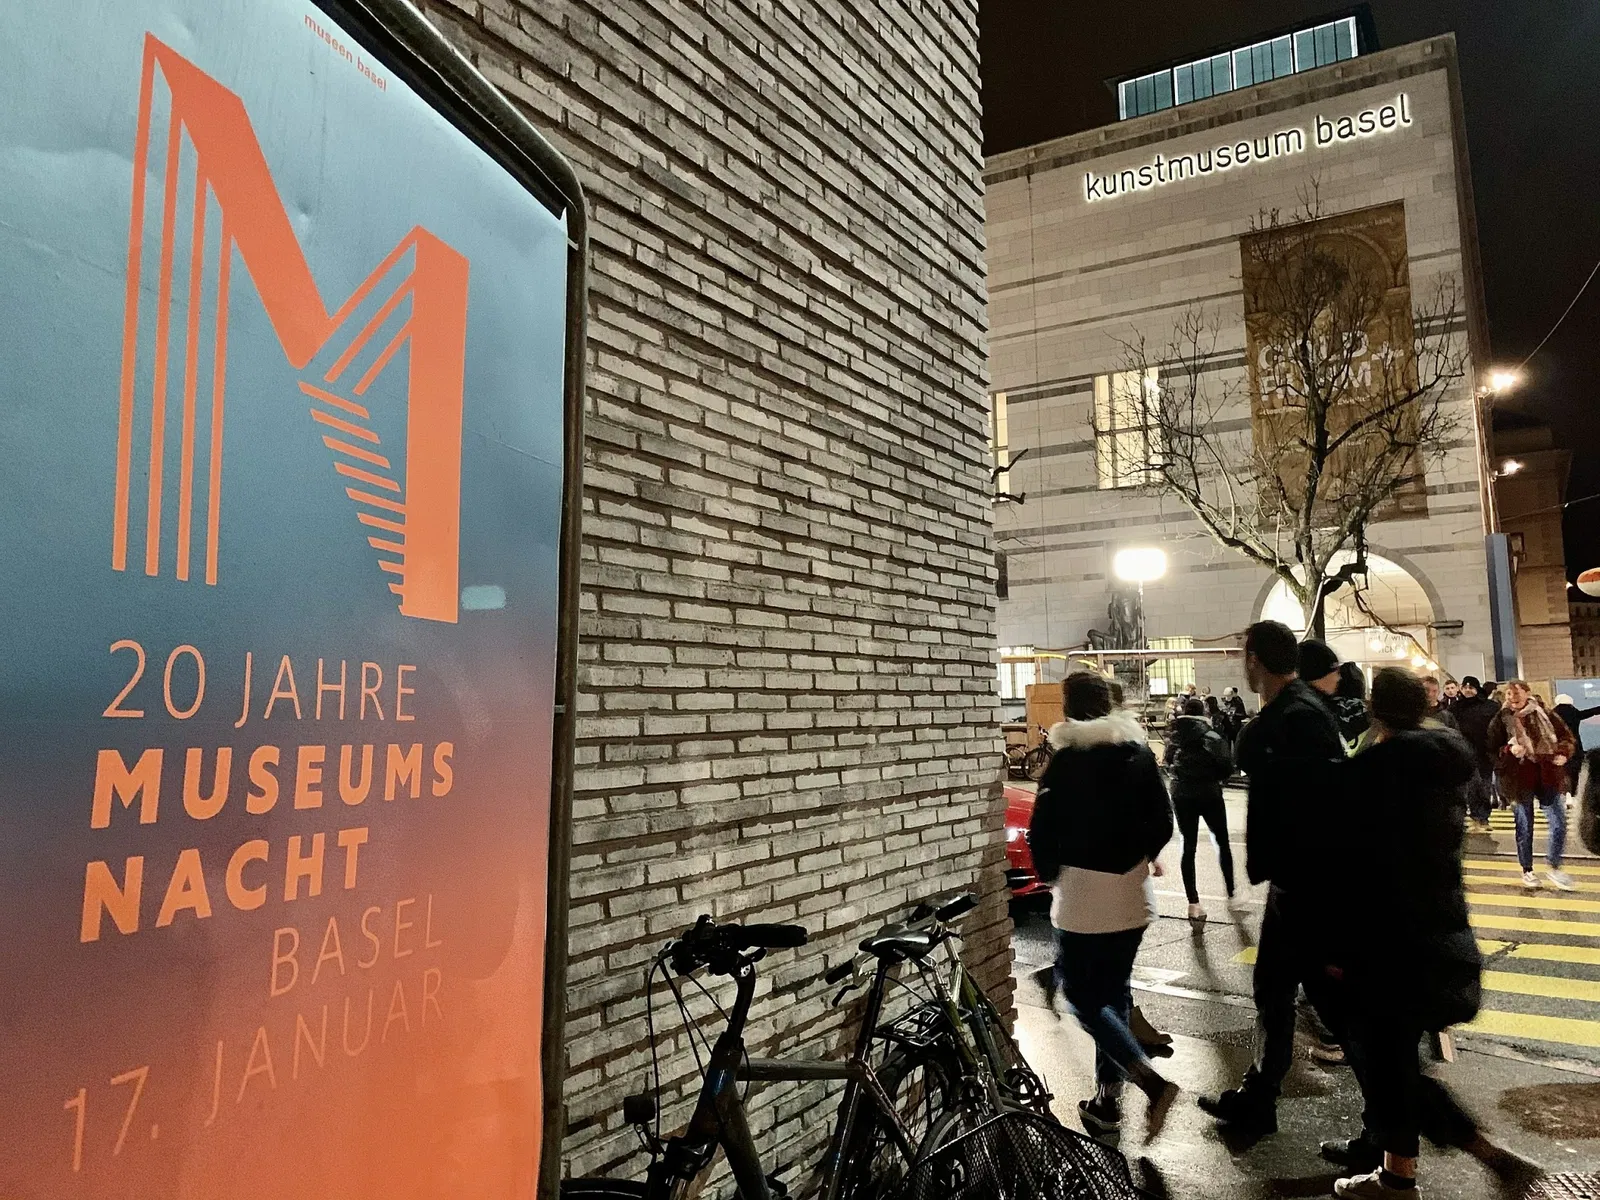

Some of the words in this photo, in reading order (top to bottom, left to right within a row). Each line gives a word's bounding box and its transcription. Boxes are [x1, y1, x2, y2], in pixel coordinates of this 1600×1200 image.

[305, 15, 352, 63] museen
[358, 56, 386, 92] basel
[1085, 127, 1303, 201] kunstmuseum
[1315, 93, 1412, 145] basel
[102, 639, 206, 720] 20
[234, 650, 417, 728] JAHRE
[90, 741, 456, 829] MUSEUMS
[80, 827, 370, 943] NACHT
[270, 893, 443, 998] BASEL
[63, 1065, 159, 1173] 17.
[204, 967, 444, 1128] JANUAR
